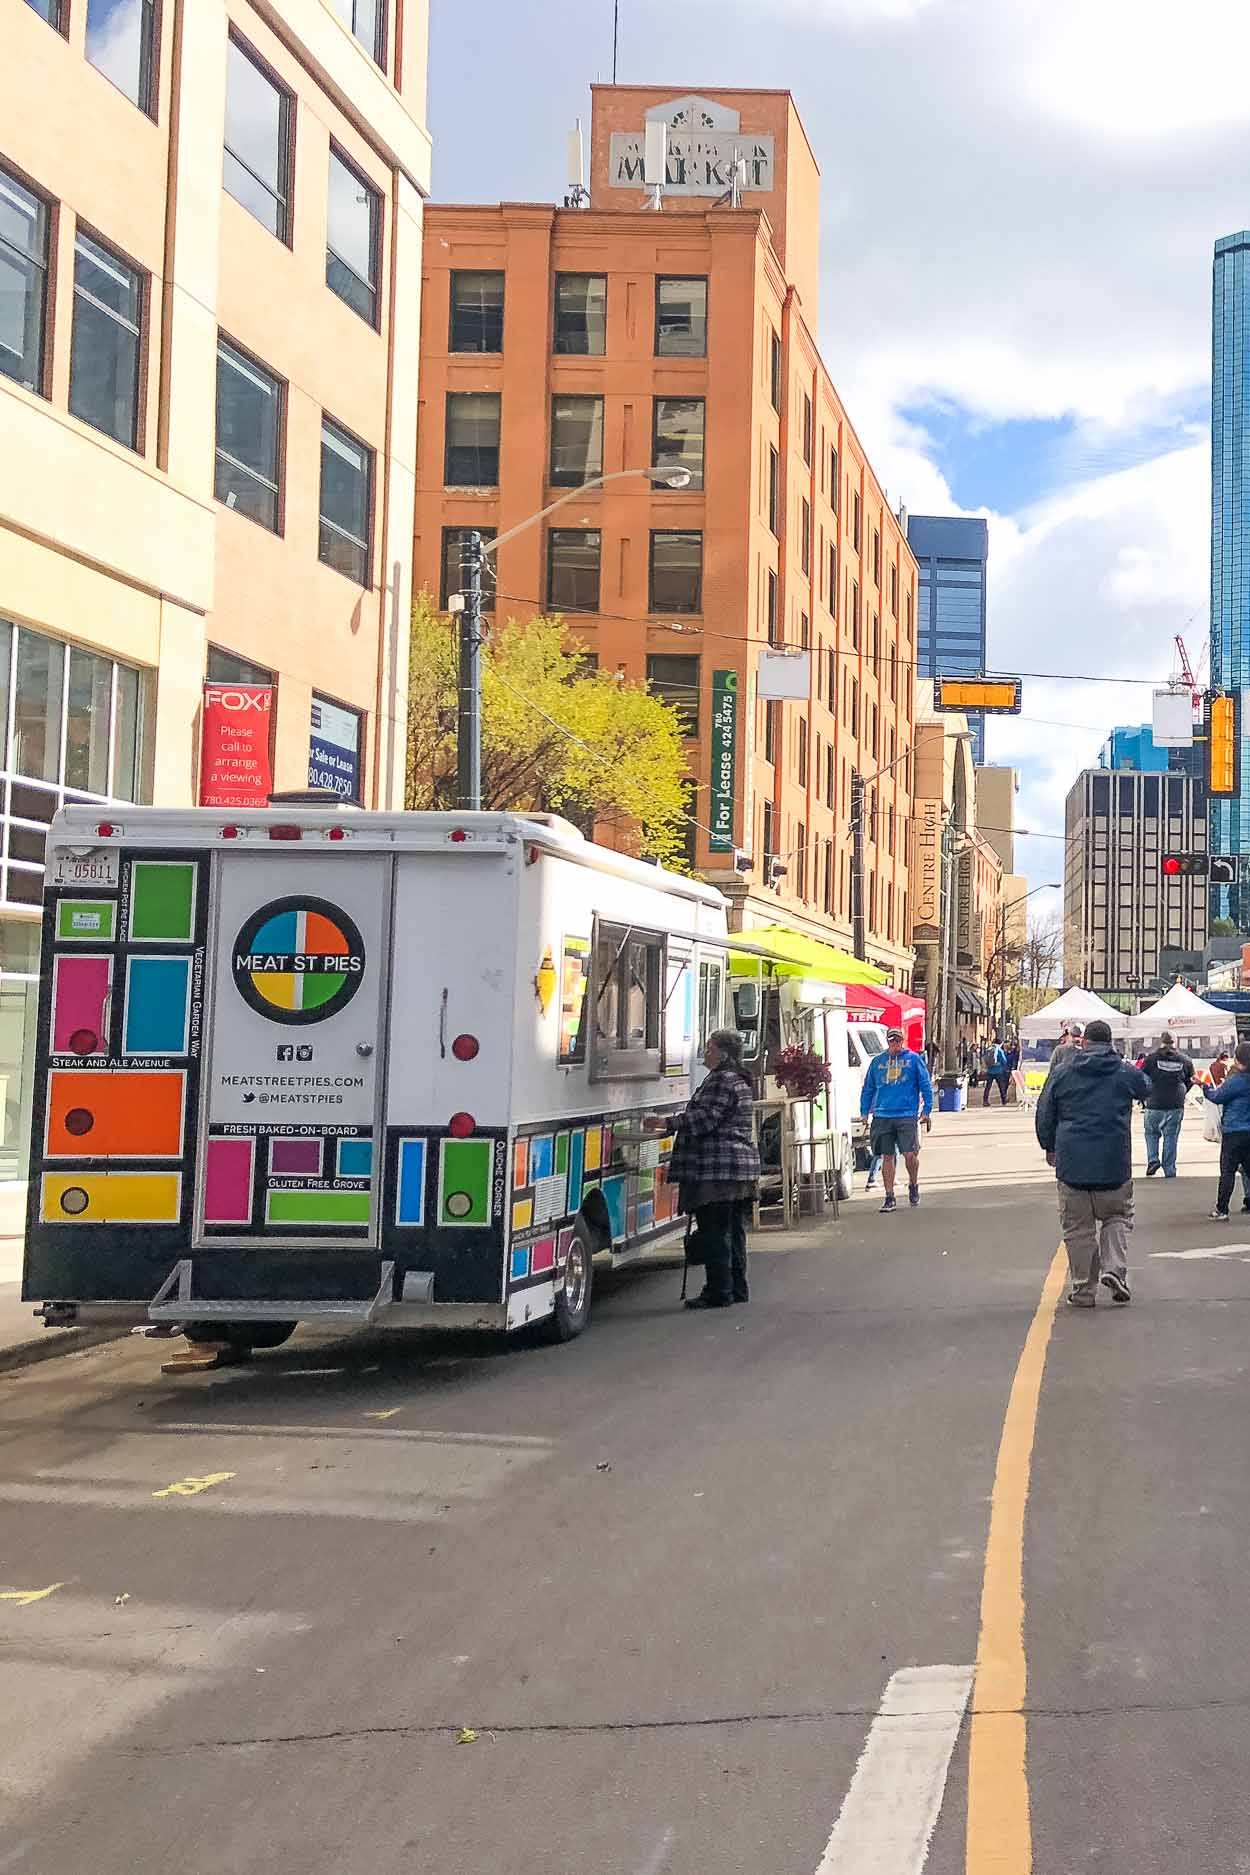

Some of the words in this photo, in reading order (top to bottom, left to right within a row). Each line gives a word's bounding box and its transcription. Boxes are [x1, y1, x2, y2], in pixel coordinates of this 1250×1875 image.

[205, 690, 263, 711] FOX
[722, 695, 733, 722] 5475
[715, 712, 723, 728] 780
[220, 725, 253, 736] Please
[721, 724, 732, 747] 424
[221, 741, 241, 751] call
[242, 744, 252, 752] to
[215, 759, 258, 769] arrange
[315, 748, 328, 764] Sale
[328, 755, 336, 767] or
[336, 755, 353, 773] Lease
[220, 772, 262, 784] viewing
[717, 752, 732, 798] Lease
[715, 803, 730, 829] For
[236, 955, 288, 970] MEAT
[294, 956, 318, 970] ST
[324, 956, 361, 971] PIES
[193, 946, 204, 998] VEGETARIAN
[191, 1001, 202, 1037] GARDEN
[850, 1011, 882, 1022] TENT
[190, 1040, 201, 1058] WAY
[110, 1059, 128, 1067] ALE
[131, 1059, 170, 1067] AVENUE
[221, 1076, 364, 1087] MEATSTREETPIES.COM
[259, 1094, 343, 1104] @MEATSTPIES
[223, 1125, 256, 1134] FRESH
[258, 1125, 358, 1135] BAKED-ON-BOARD
[307, 1180, 330, 1188] FREE
[493, 1178, 504, 1217] CORNER
